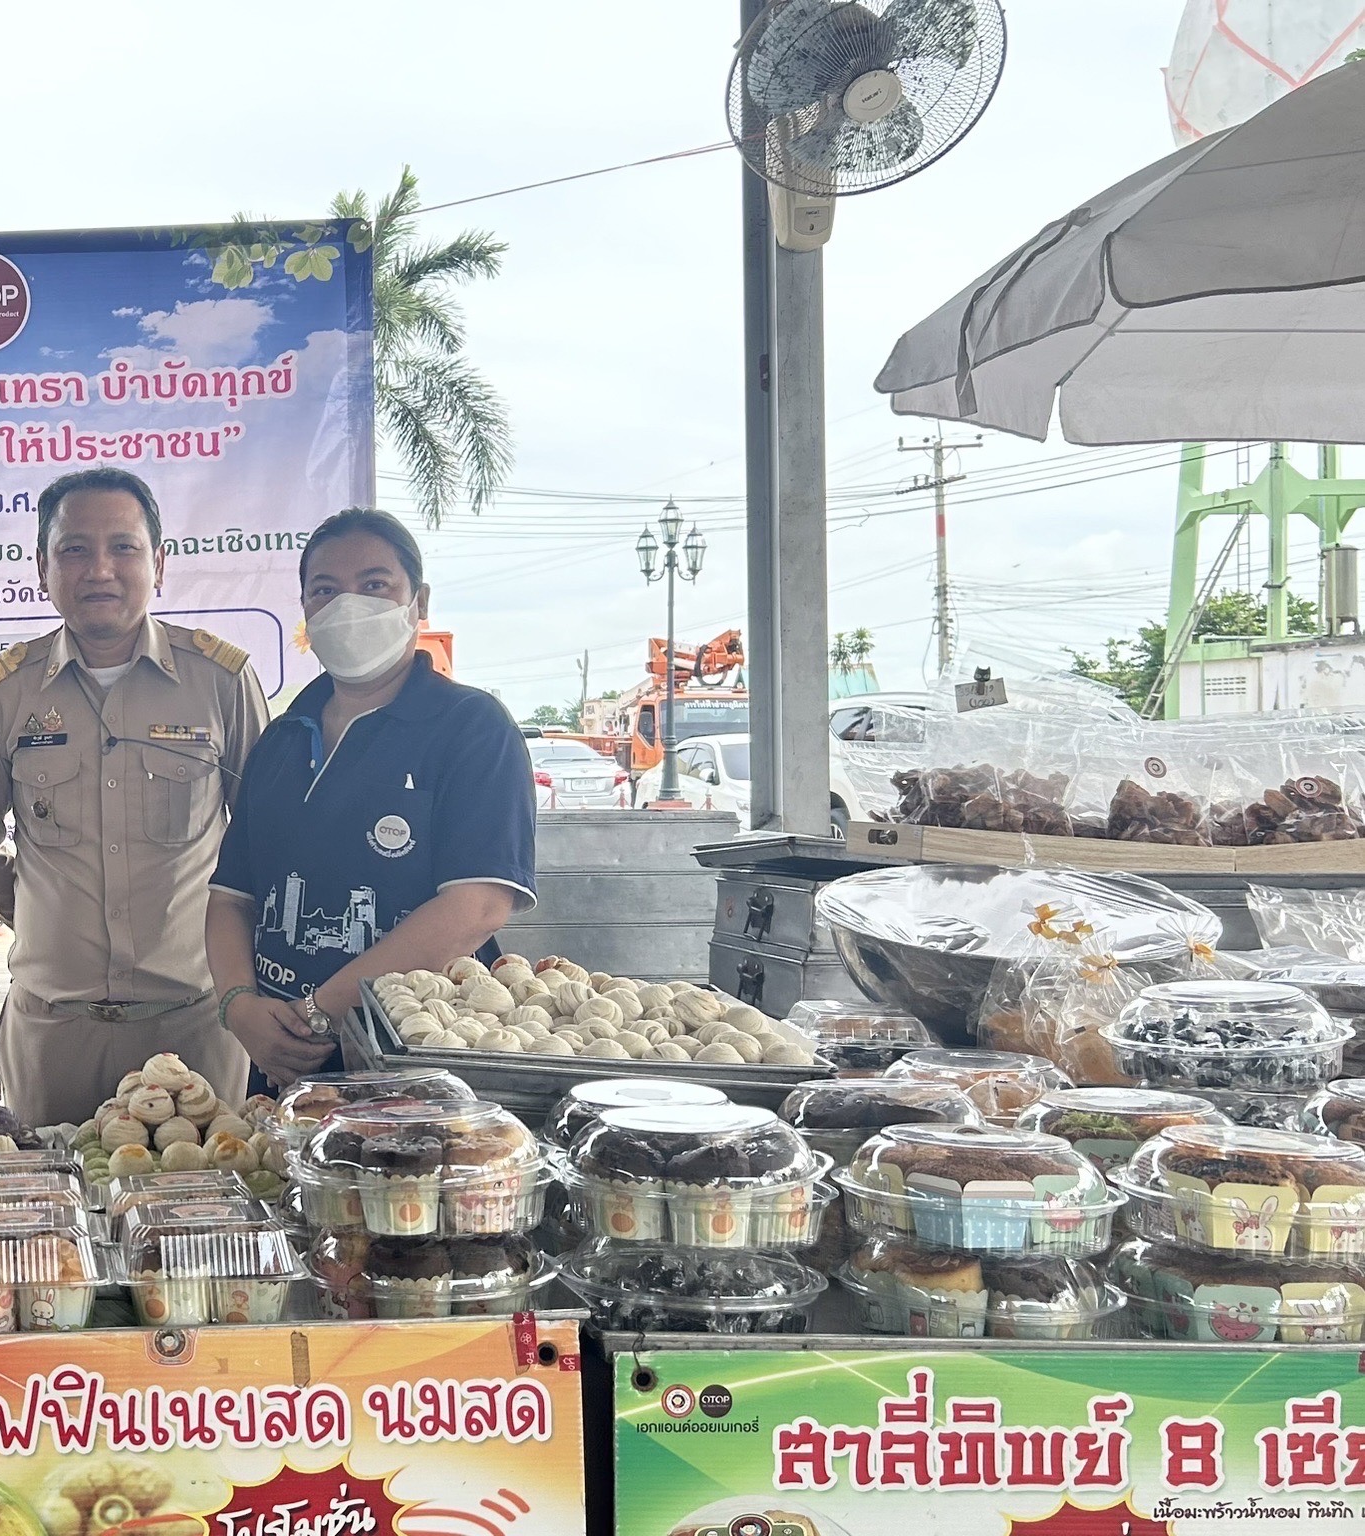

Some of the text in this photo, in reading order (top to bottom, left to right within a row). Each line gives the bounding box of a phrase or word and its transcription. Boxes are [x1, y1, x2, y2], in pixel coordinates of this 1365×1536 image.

[102, 356, 294, 407] บำบัดทุกข์
[379, 825, 407, 837] OTOP
[255, 952, 296, 986] OTOP
[562, 1357, 576, 1371] yo
[367, 1382, 546, 1439] นมสด
[701, 1395, 730, 1404] OTOP
[636, 1415, 760, 1433] เอกแอนด์ออยเบเกอรี่
[778, 1371, 1129, 1486] สาลี่ทิพย์
[1165, 1421, 1219, 1487] 8
[1153, 1497, 1300, 1519] เนื้อมะพร้าวน้ำหอม
[1306, 1500, 1354, 1518] ทึนทึก
